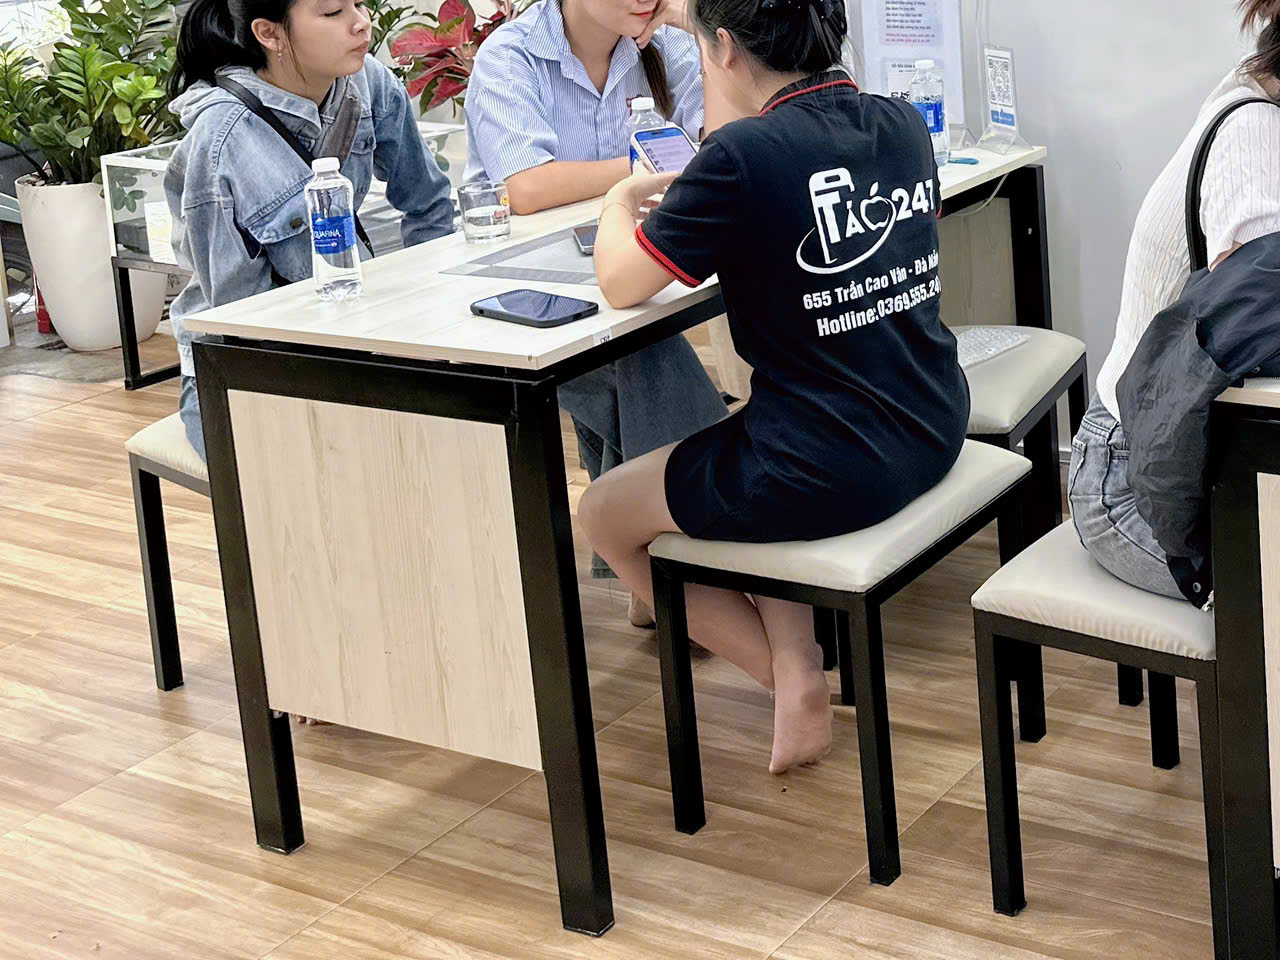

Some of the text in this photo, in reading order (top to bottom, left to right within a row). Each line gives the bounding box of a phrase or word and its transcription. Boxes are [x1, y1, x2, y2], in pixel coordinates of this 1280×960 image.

[803, 290, 832, 310] 655
[835, 281, 865, 303] Trần
[865, 275, 889, 294] Cao
[889, 267, 907, 286] Vân
[914, 257, 928, 276] Đà
